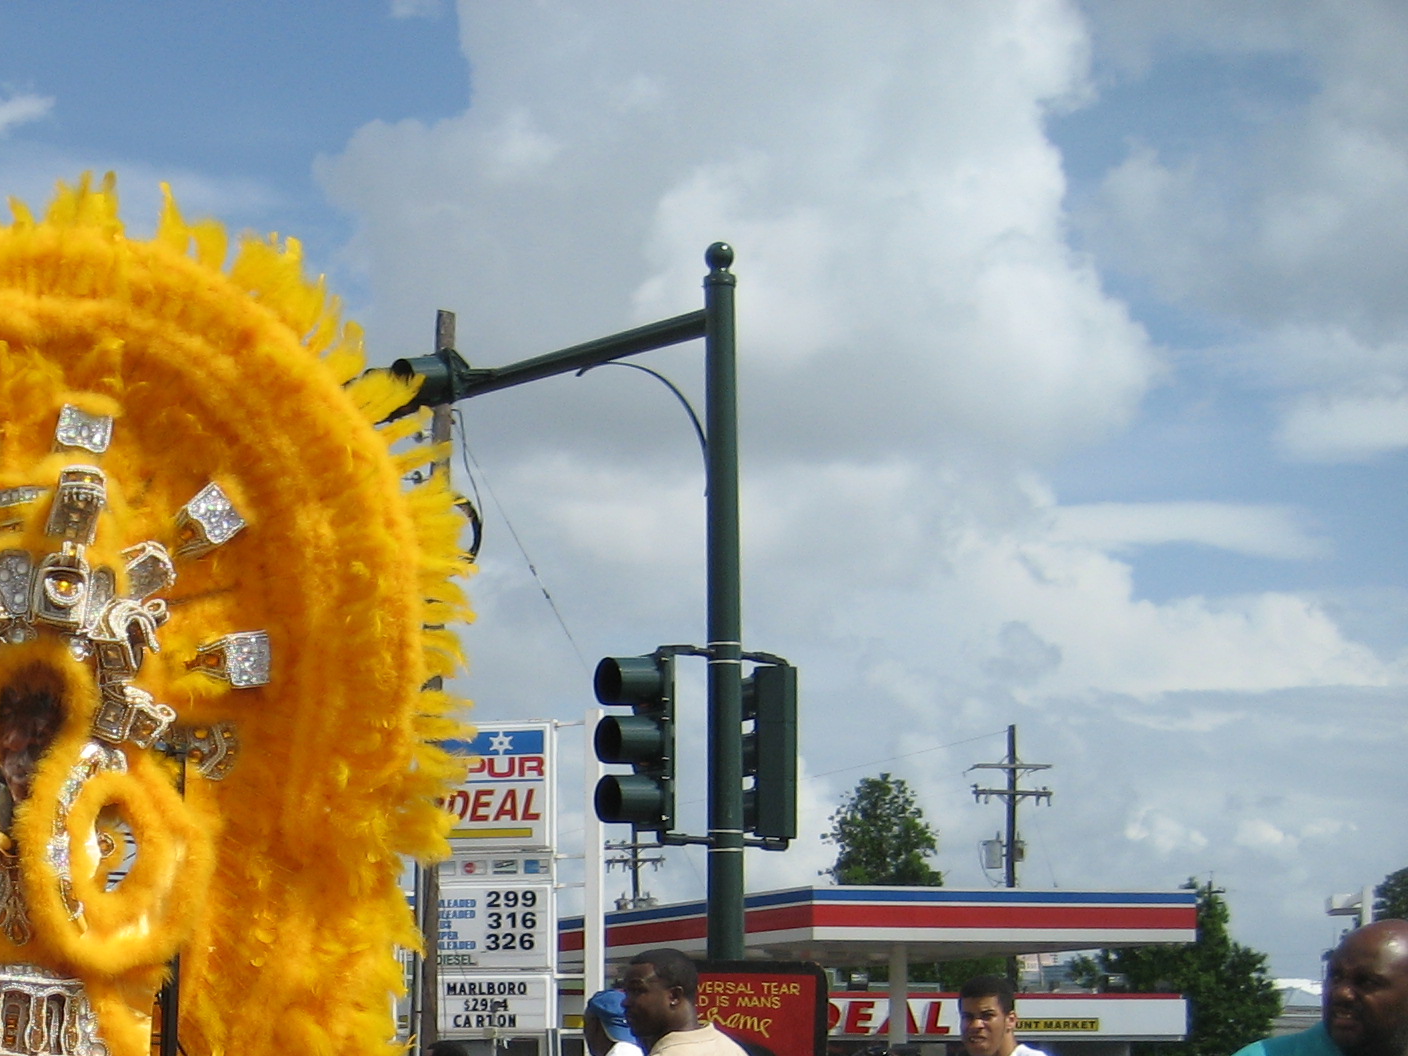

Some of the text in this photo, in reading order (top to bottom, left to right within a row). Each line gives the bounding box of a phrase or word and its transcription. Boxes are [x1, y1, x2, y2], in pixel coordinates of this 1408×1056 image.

[437, 788, 542, 822] DEAL
[485, 890, 537, 908] 299
[487, 911, 537, 930] 316
[485, 932, 536, 951] 326
[446, 981, 528, 996] MARLBORO
[761, 982, 801, 997] TEAR
[716, 995, 730, 1008] IS
[452, 1014, 517, 1028] CARTON
[1043, 1020, 1096, 1030] MARKET
